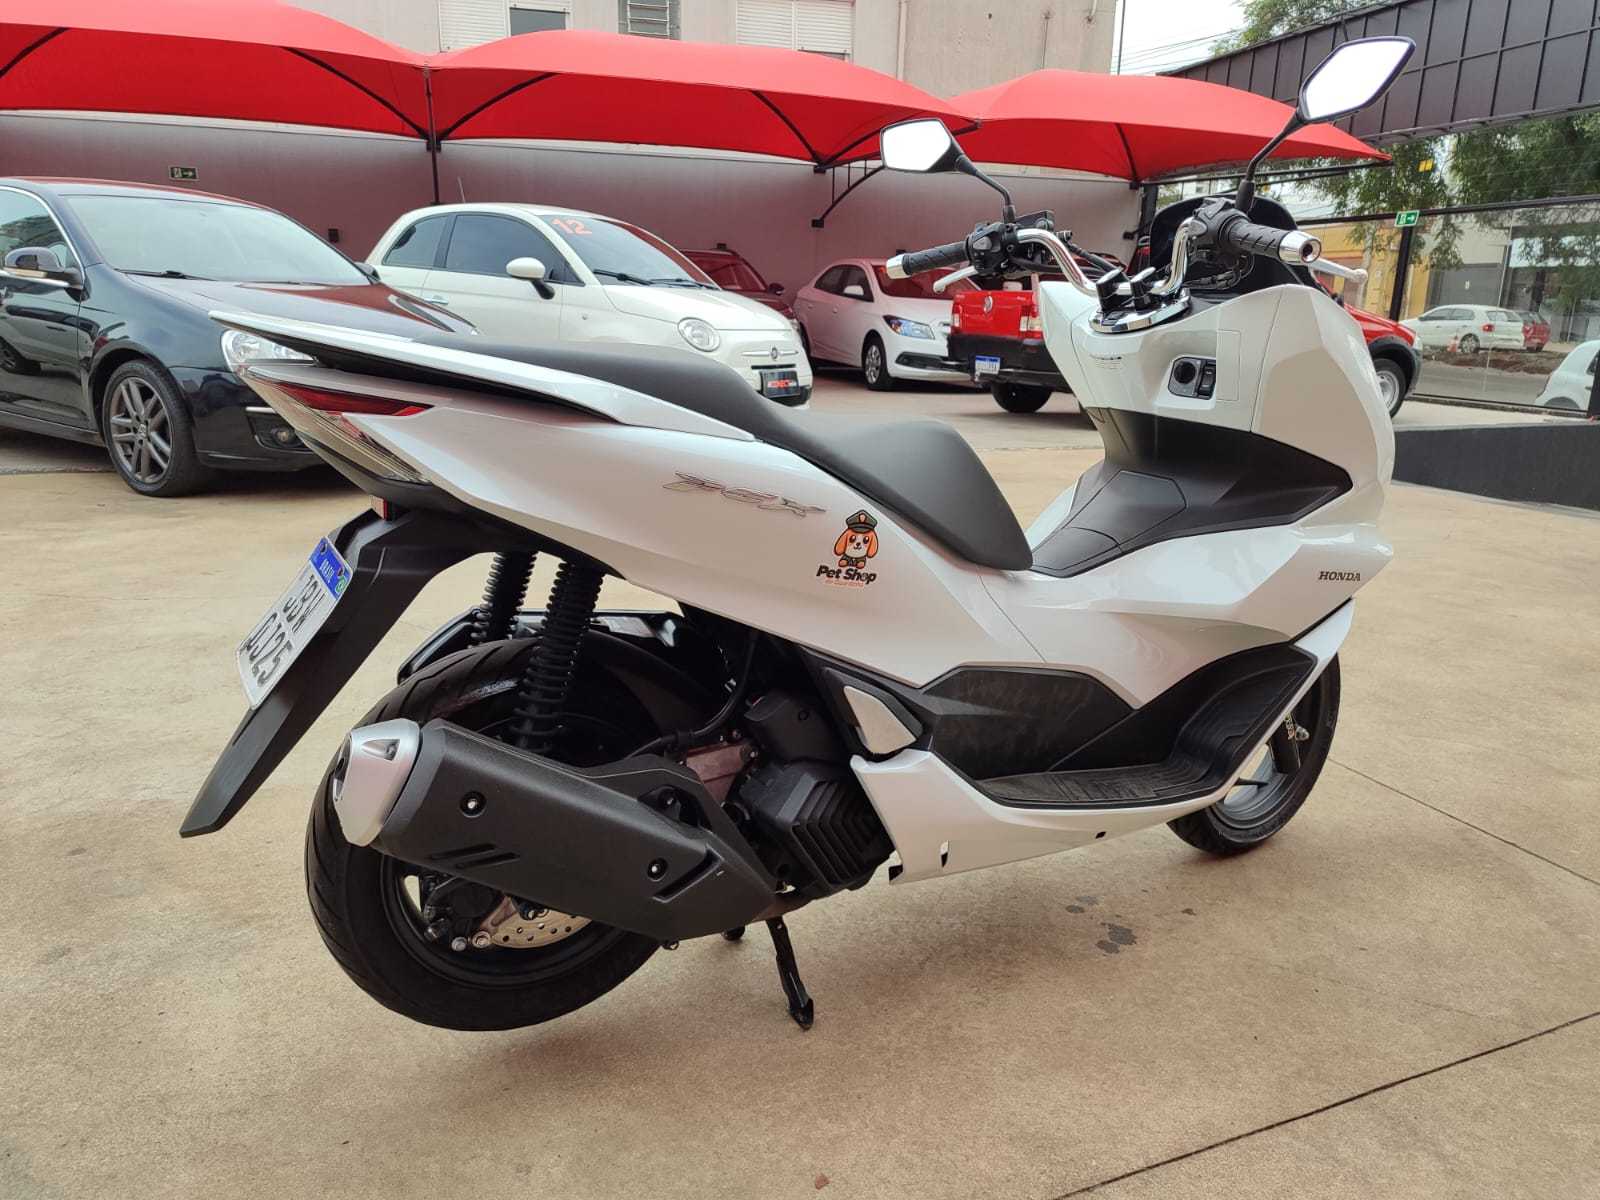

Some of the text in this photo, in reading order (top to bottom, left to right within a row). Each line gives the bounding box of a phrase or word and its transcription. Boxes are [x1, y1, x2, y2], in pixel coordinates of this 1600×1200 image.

[552, 218, 592, 235] 12
[816, 565, 842, 579] Pet
[843, 568, 877, 585] Shop
[1318, 571, 1361, 582] HONDA
